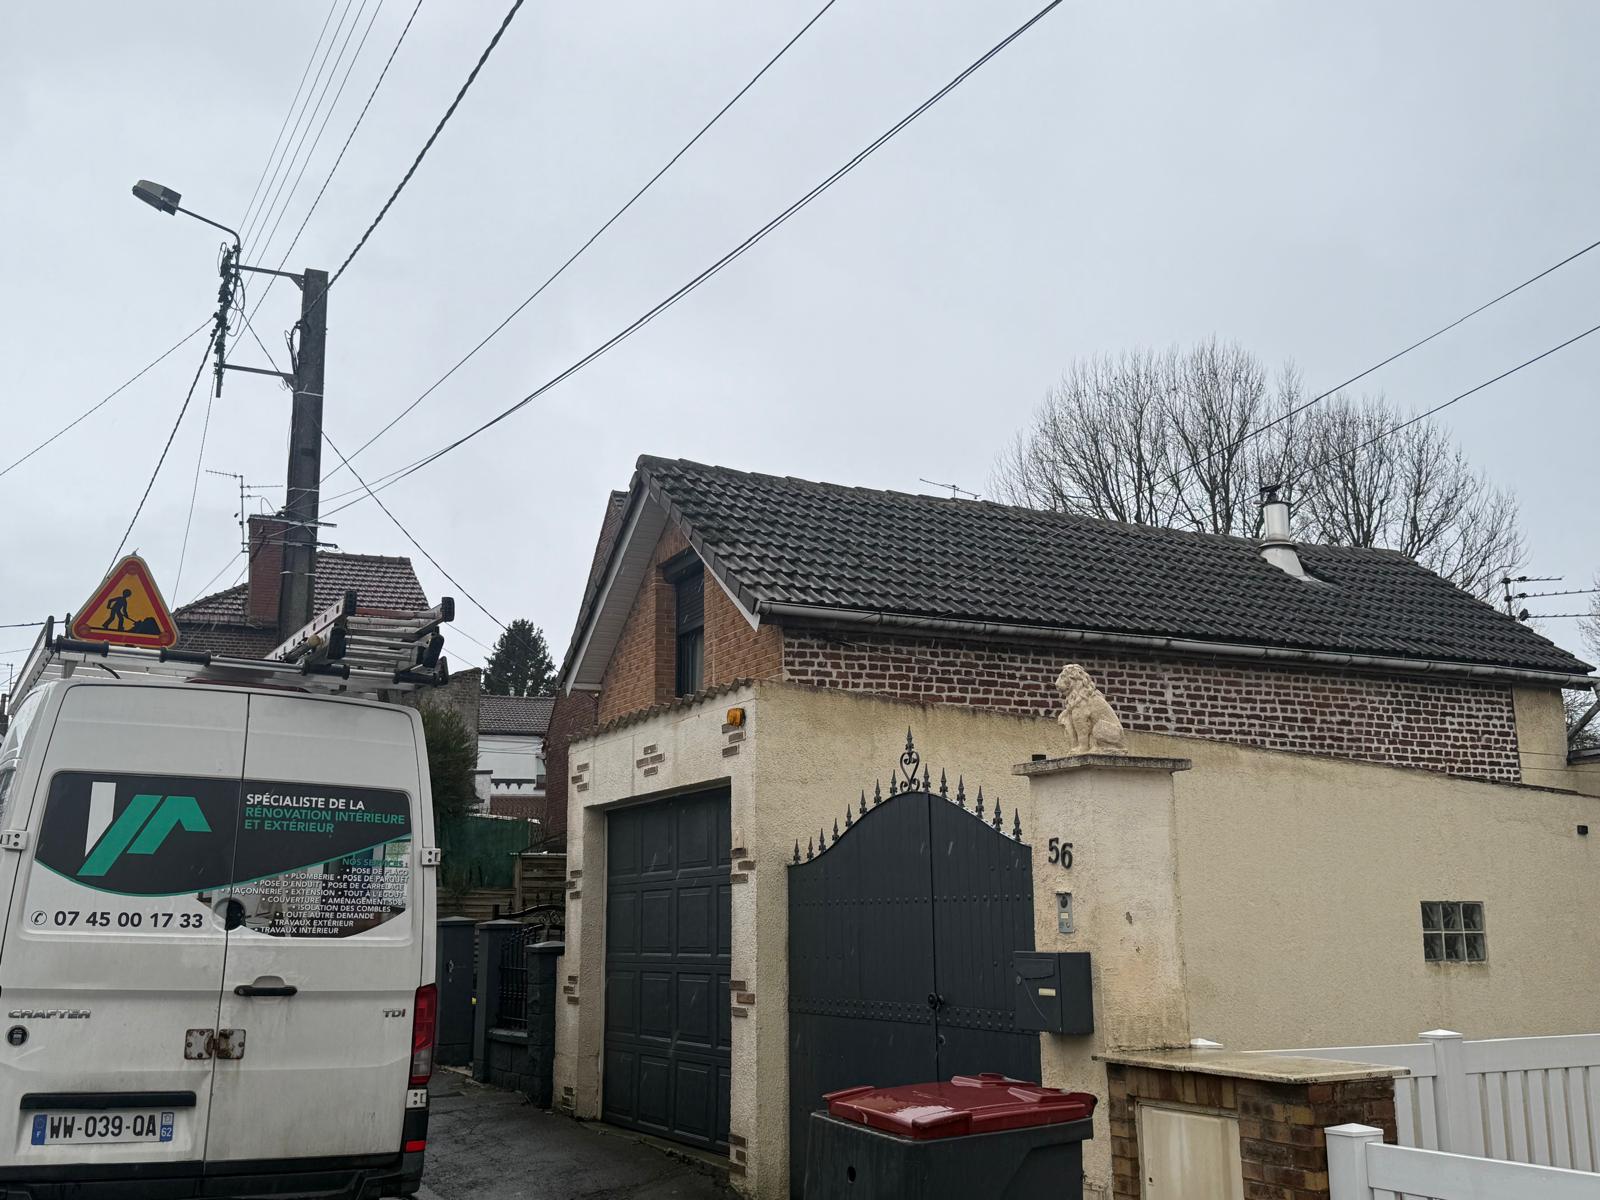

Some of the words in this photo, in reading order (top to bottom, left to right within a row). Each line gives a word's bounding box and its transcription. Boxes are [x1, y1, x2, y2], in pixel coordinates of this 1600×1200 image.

[246, 792, 327, 808] SPÉCIALISTE
[329, 798, 346, 809] DE
[350, 799, 364, 810] LA
[246, 805, 333, 821] RÉNOVATION
[335, 810, 405, 824] INTÉRIEURE
[245, 821, 262, 830] ET
[264, 819, 334, 832] EXTÉRIEUR
[1048, 837, 1073, 870] 56
[54, 910, 79, 927] 07
[86, 911, 111, 927] 45
[117, 912, 143, 928] 00
[150, 912, 174, 928] 17
[180, 913, 203, 929] 33
[313, 918, 354, 927] EXTÉRIEUR
[8, 1009, 92, 1019] CRAFTER
[383, 1008, 407, 1019] TDI
[50, 1114, 156, 1138] WW-039-QA
[161, 1128, 172, 1137] 62
